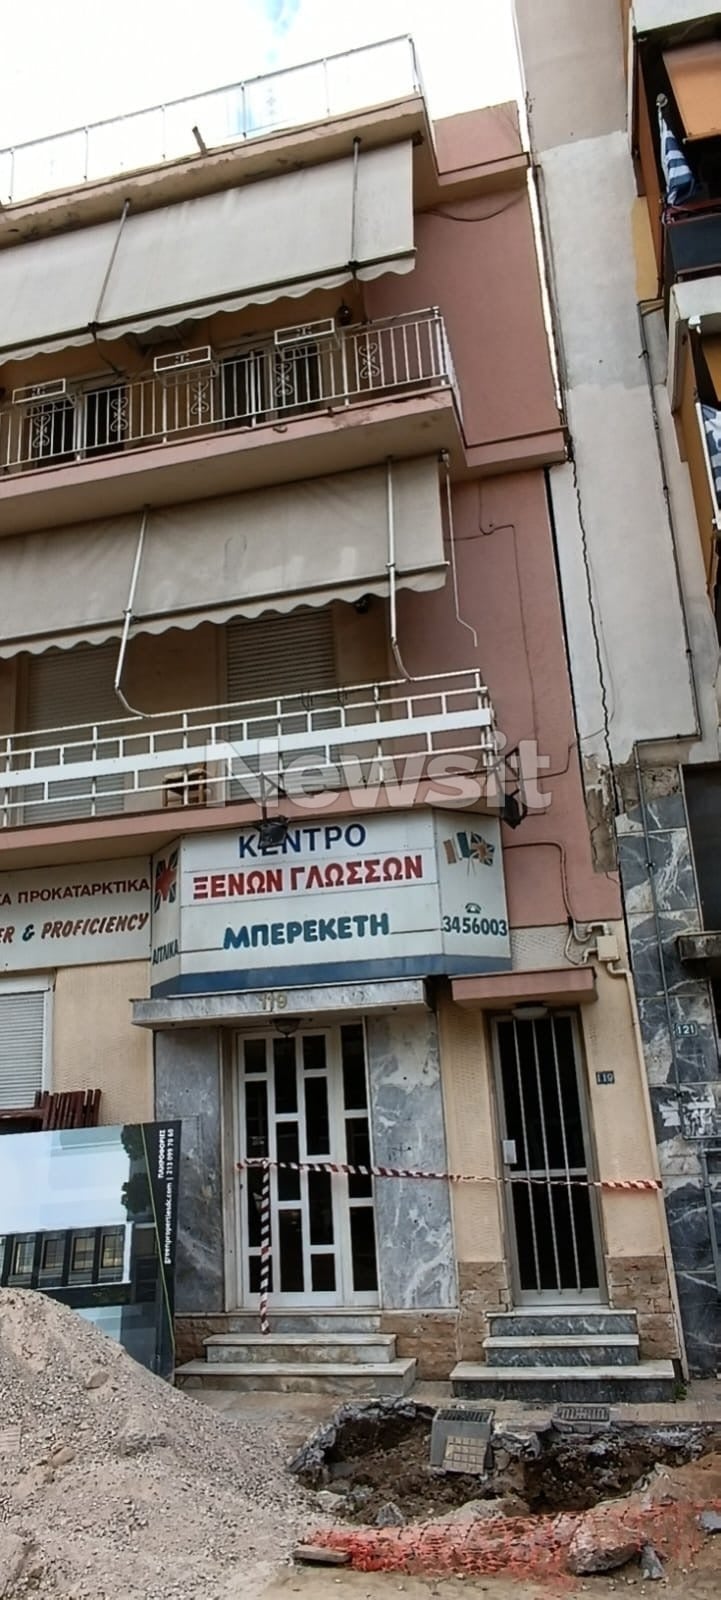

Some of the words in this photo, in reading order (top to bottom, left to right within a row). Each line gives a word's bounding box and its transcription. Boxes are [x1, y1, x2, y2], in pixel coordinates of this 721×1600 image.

[0, 892, 12, 906] Α
[18, 878, 150, 904] ΠΡΟΚΑΤΑΡΚΤΙΚΑ
[193, 869, 283, 900] ΞΕΝΩΝ
[290, 855, 423, 890] ΓΛΩΣΣΩΝ
[22, 924, 35, 942] &
[41, 912, 149, 940] PROFICIENCY
[223, 913, 389, 949] ΜΠΕΡΕΚΕΤΗ
[442, 915, 508, 937] 3456003
[677, 1024, 695, 1035] 121
